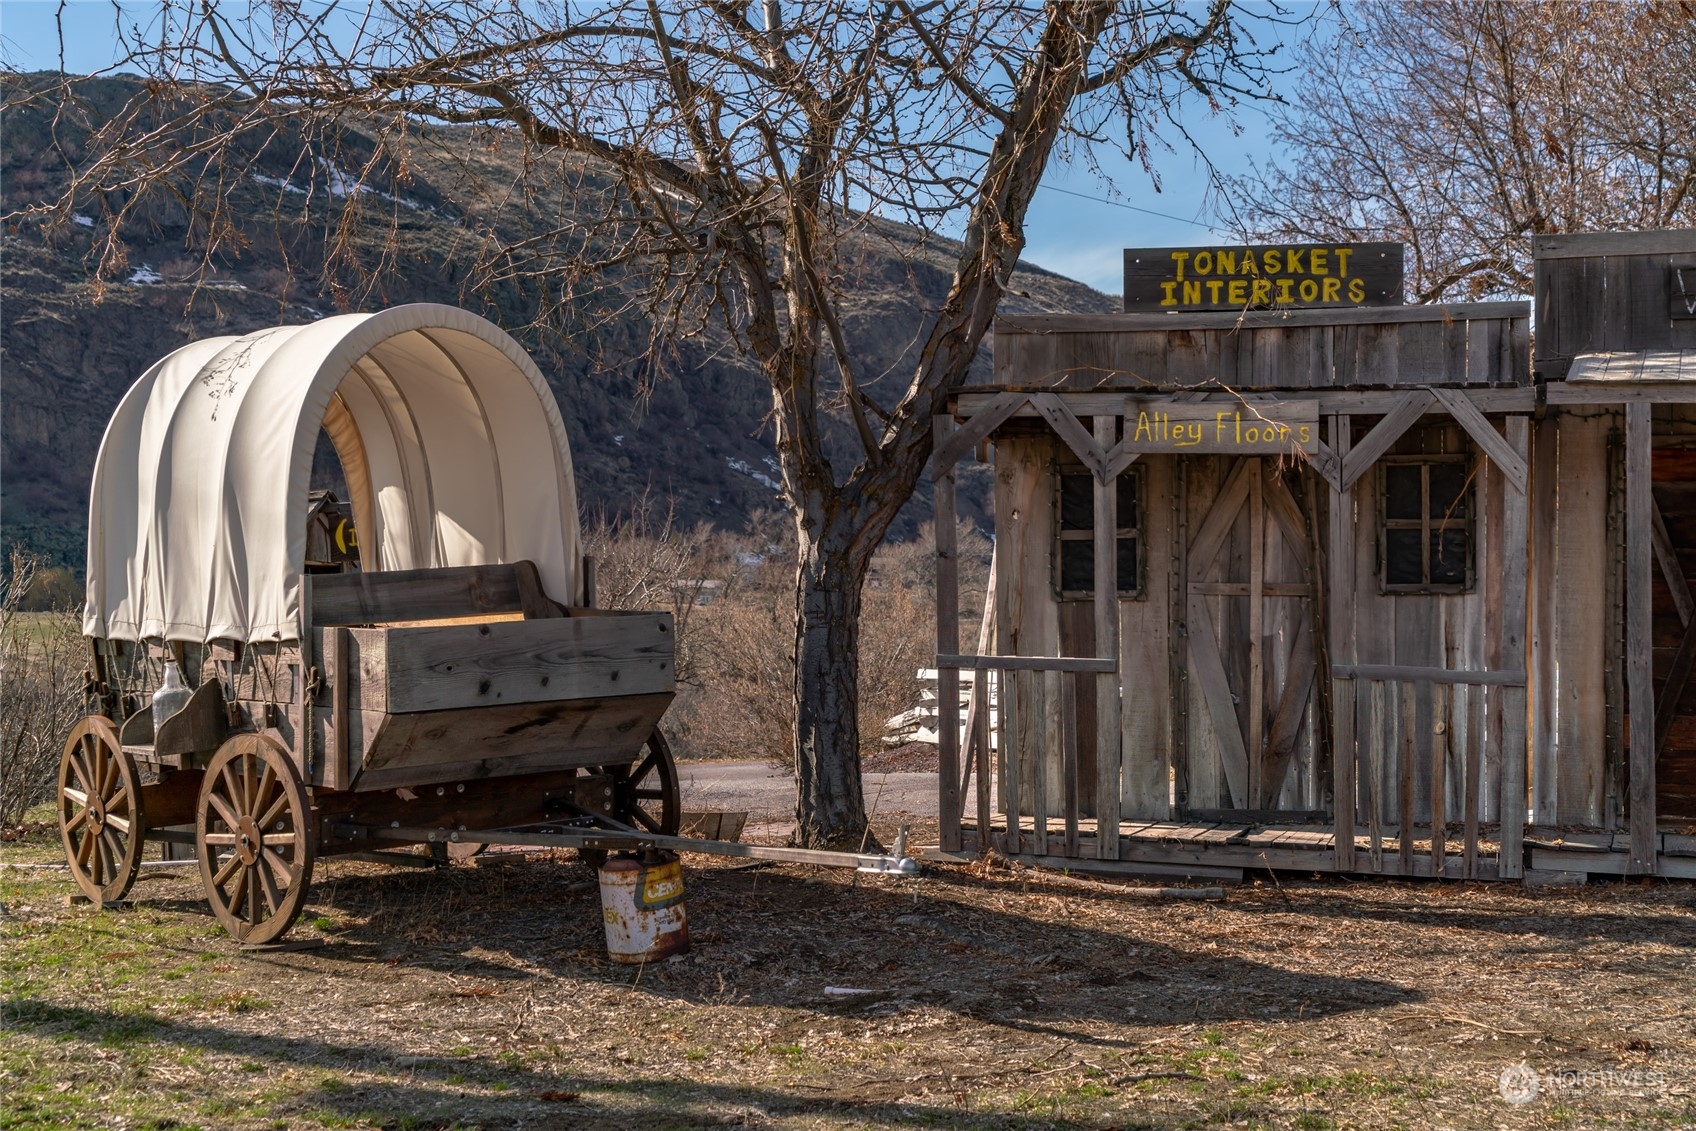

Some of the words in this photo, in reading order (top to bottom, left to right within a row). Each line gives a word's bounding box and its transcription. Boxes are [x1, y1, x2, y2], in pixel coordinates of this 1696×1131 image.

[1171, 249, 1353, 282] TONASKET
[1160, 278, 1366, 306] INTERIORS
[1134, 411, 1202, 446] Alley
[1216, 411, 1310, 444] Floors
